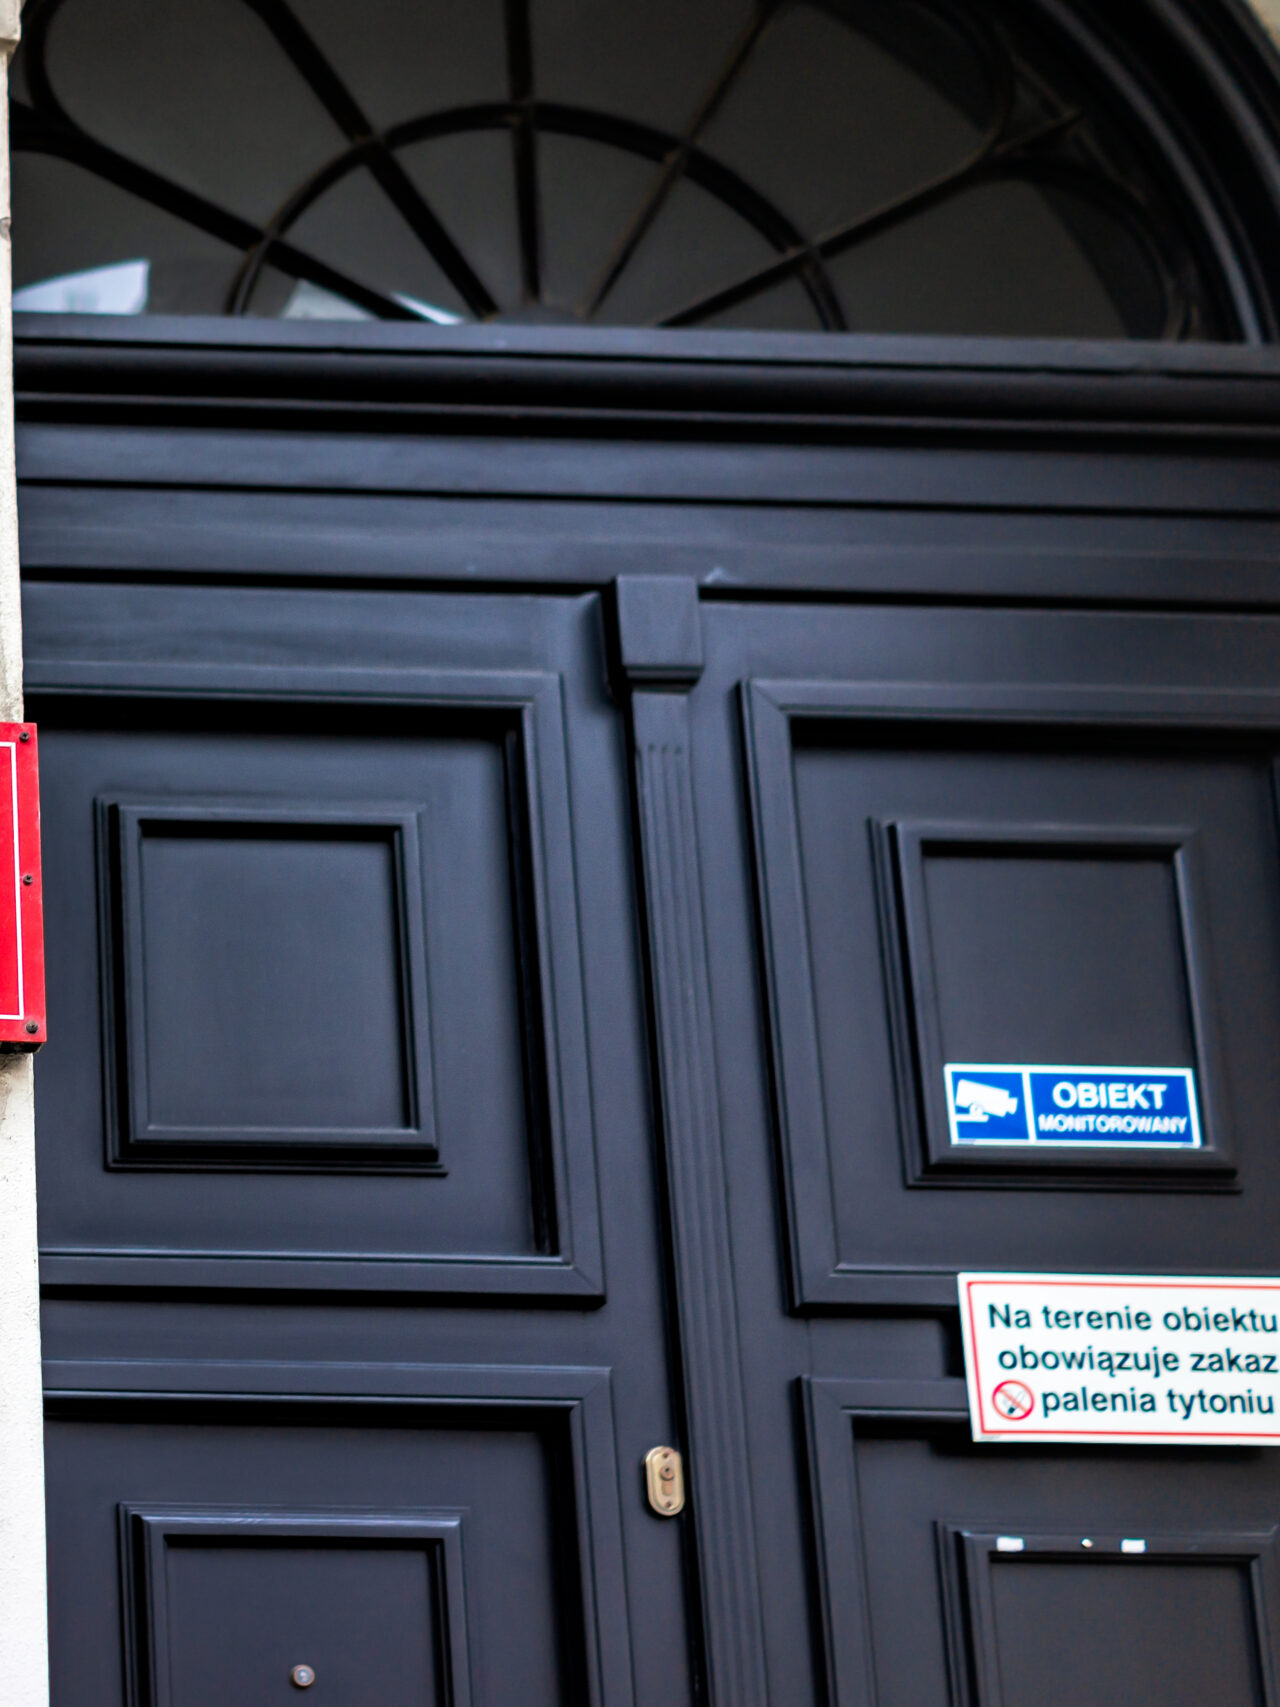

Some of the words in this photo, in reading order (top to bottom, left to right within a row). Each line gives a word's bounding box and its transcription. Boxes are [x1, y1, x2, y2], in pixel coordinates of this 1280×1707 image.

[1052, 1081, 1167, 1109] OBIEKT
[1038, 1114, 1188, 1134] MONITOROWANY
[988, 1304, 1031, 1329] Na
[1042, 1305, 1152, 1331] terenie
[1163, 1307, 1278, 1333] obiektu
[998, 1345, 1179, 1378] obowiązuje
[1190, 1348, 1279, 1374] zakaz
[1041, 1386, 1156, 1418] palenia
[1166, 1389, 1274, 1420] tytoniu
